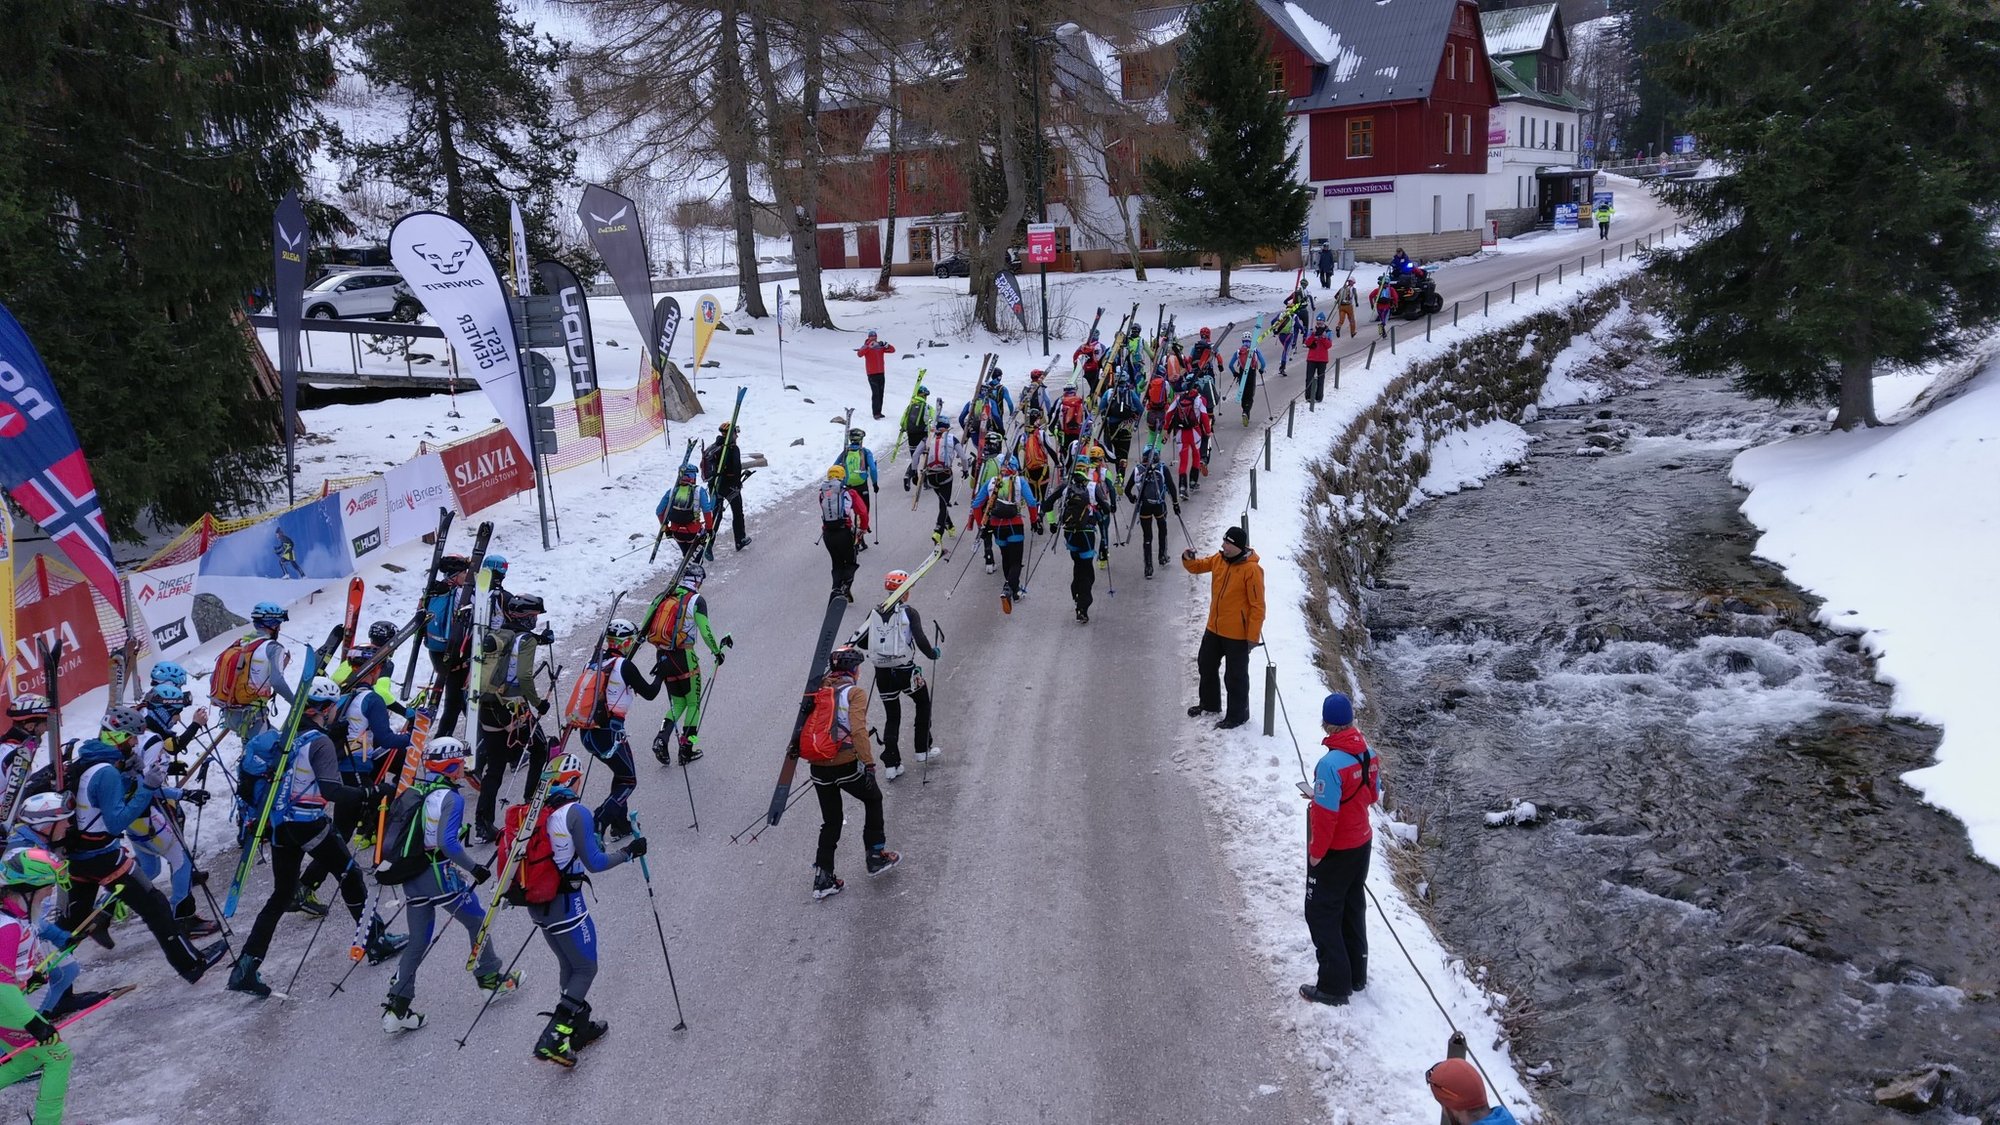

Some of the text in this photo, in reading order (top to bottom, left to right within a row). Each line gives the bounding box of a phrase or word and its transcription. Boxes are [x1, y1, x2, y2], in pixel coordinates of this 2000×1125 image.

[1324, 186, 1353, 196] PENSION
[659, 306, 679, 354] HUDY
[454, 445, 516, 488] SLAVIA
[155, 582, 193, 602] ALPINE
[157, 572, 196, 591] DIRECT
[153, 622, 183, 646] HUDY
